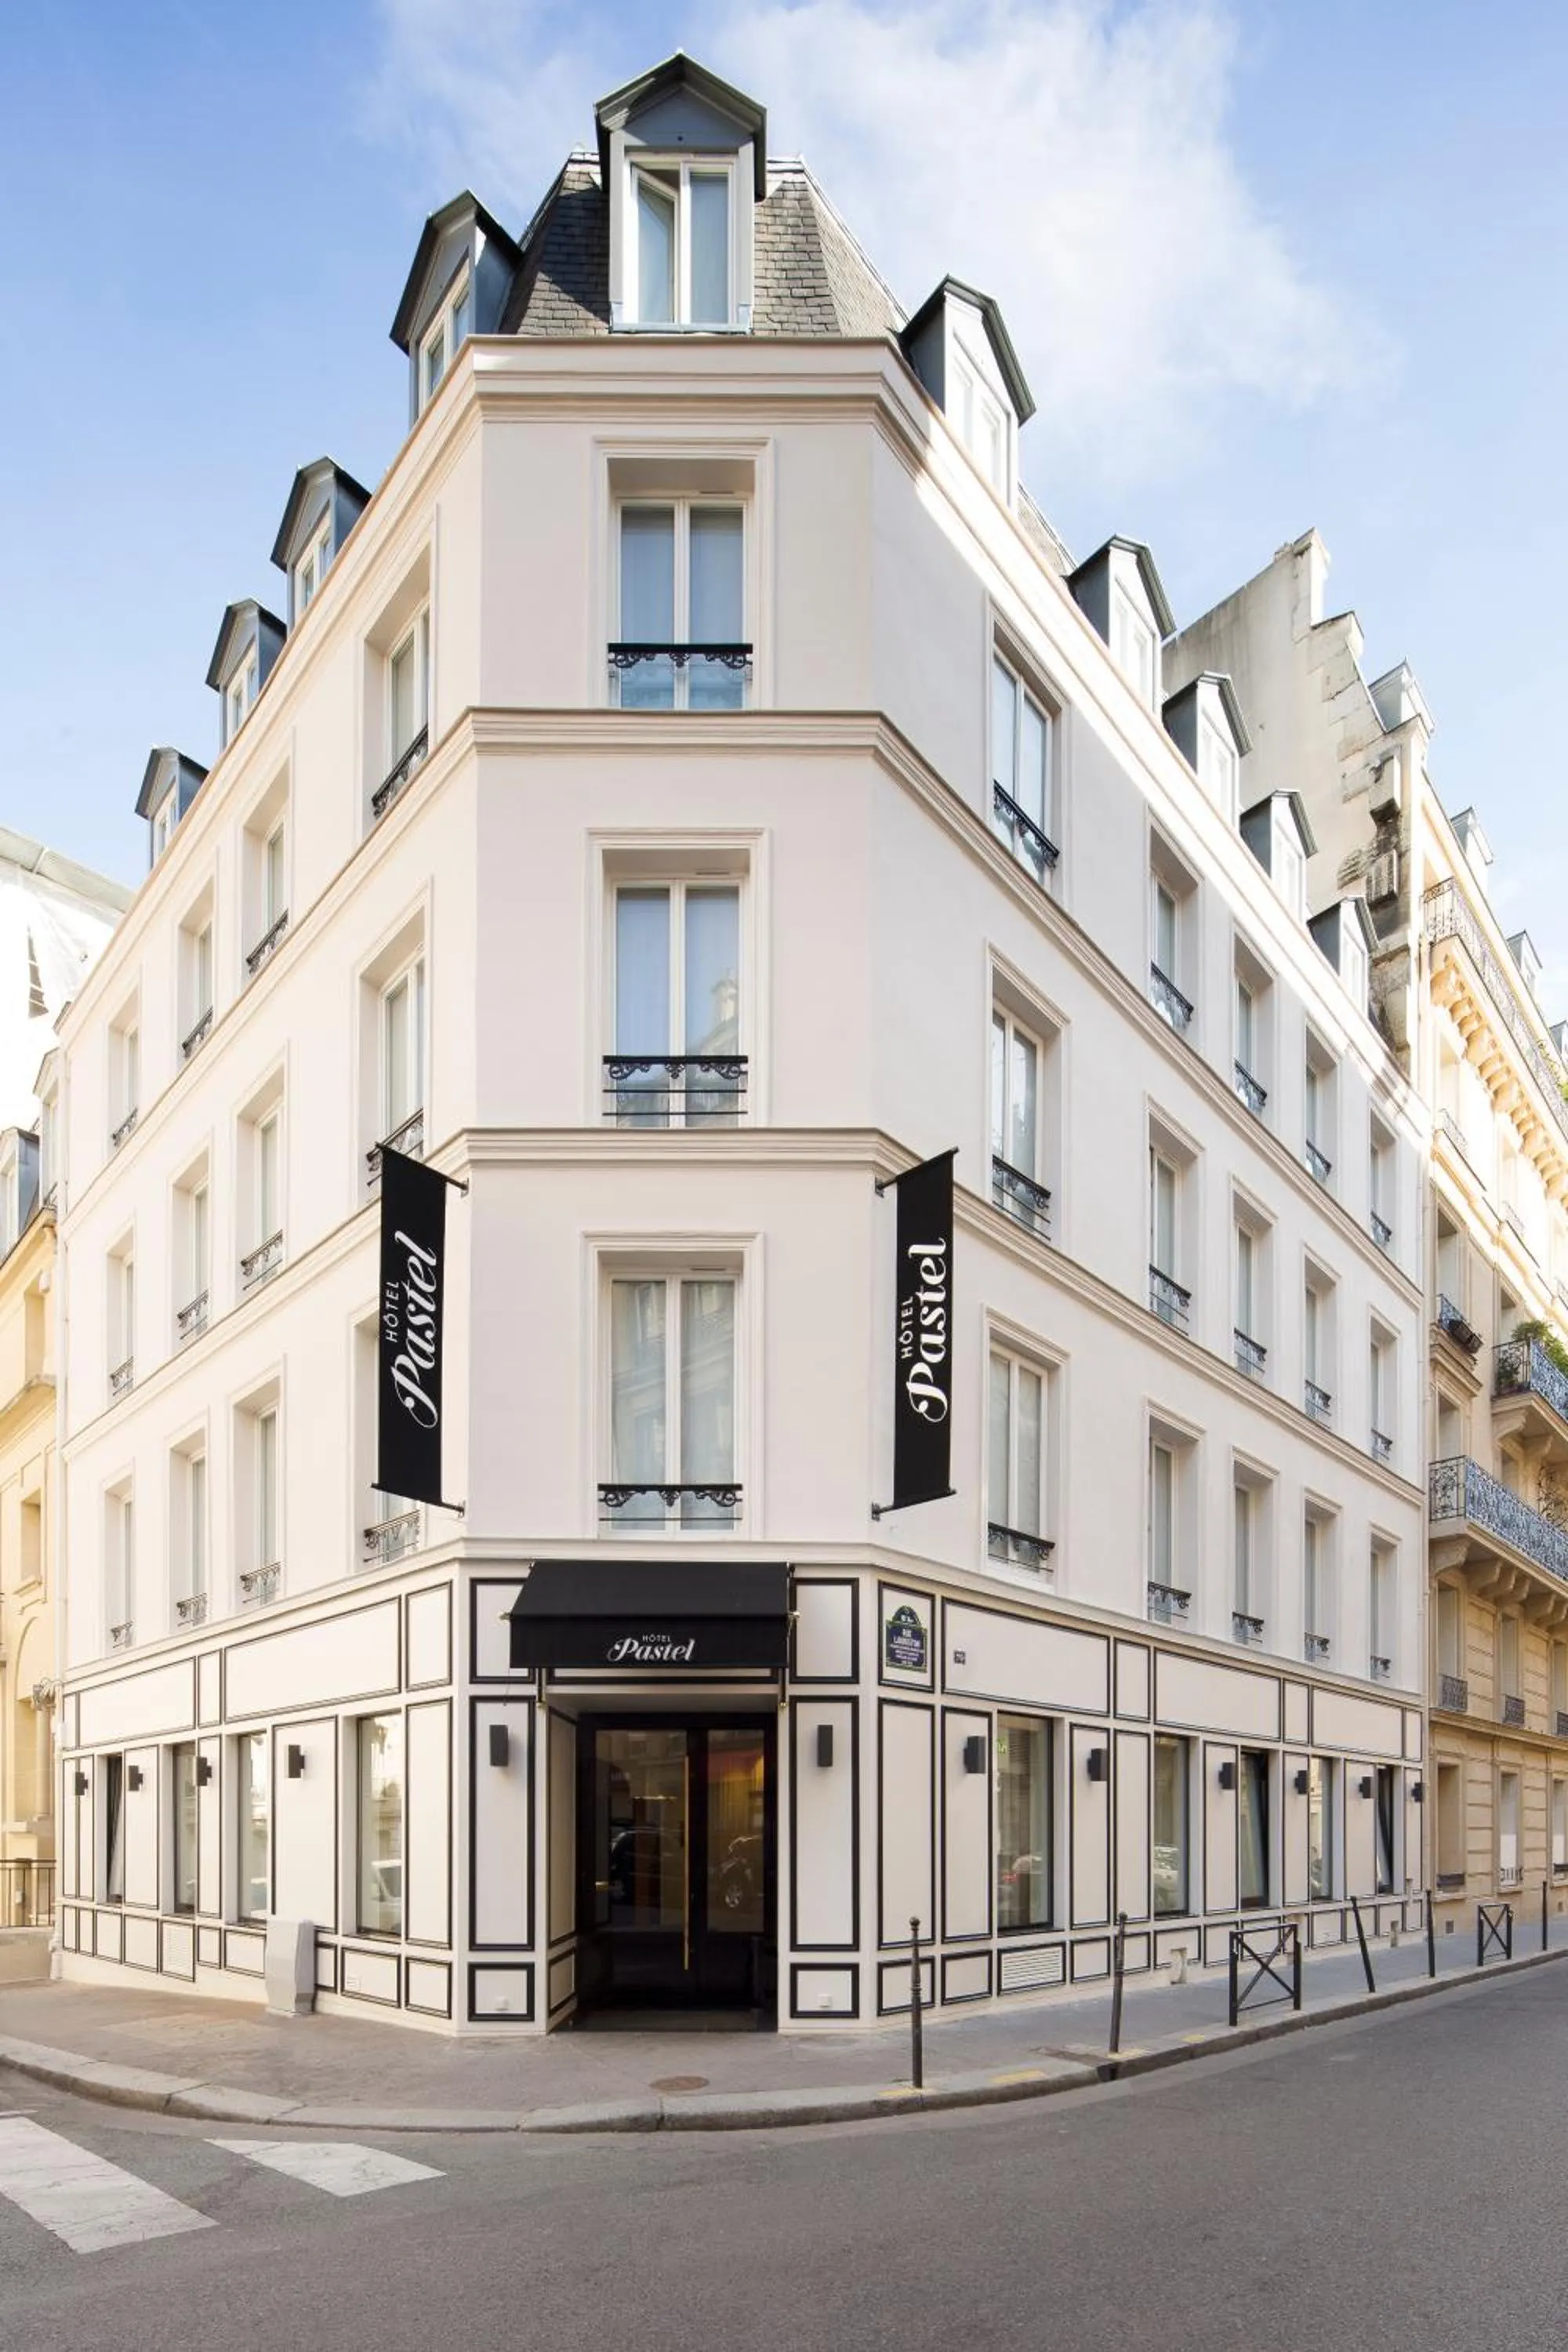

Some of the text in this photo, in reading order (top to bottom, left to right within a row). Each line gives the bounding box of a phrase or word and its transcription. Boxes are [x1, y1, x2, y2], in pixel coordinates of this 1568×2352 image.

[385, 1280, 400, 1343] HÔTEL
[391, 1230, 438, 1428] Pastel
[900, 1296, 914, 1360] HÔTEL
[906, 1237, 948, 1423] Pastel
[606, 1637, 695, 1661] Pastel
[642, 1634, 671, 1642] HÔTEL
